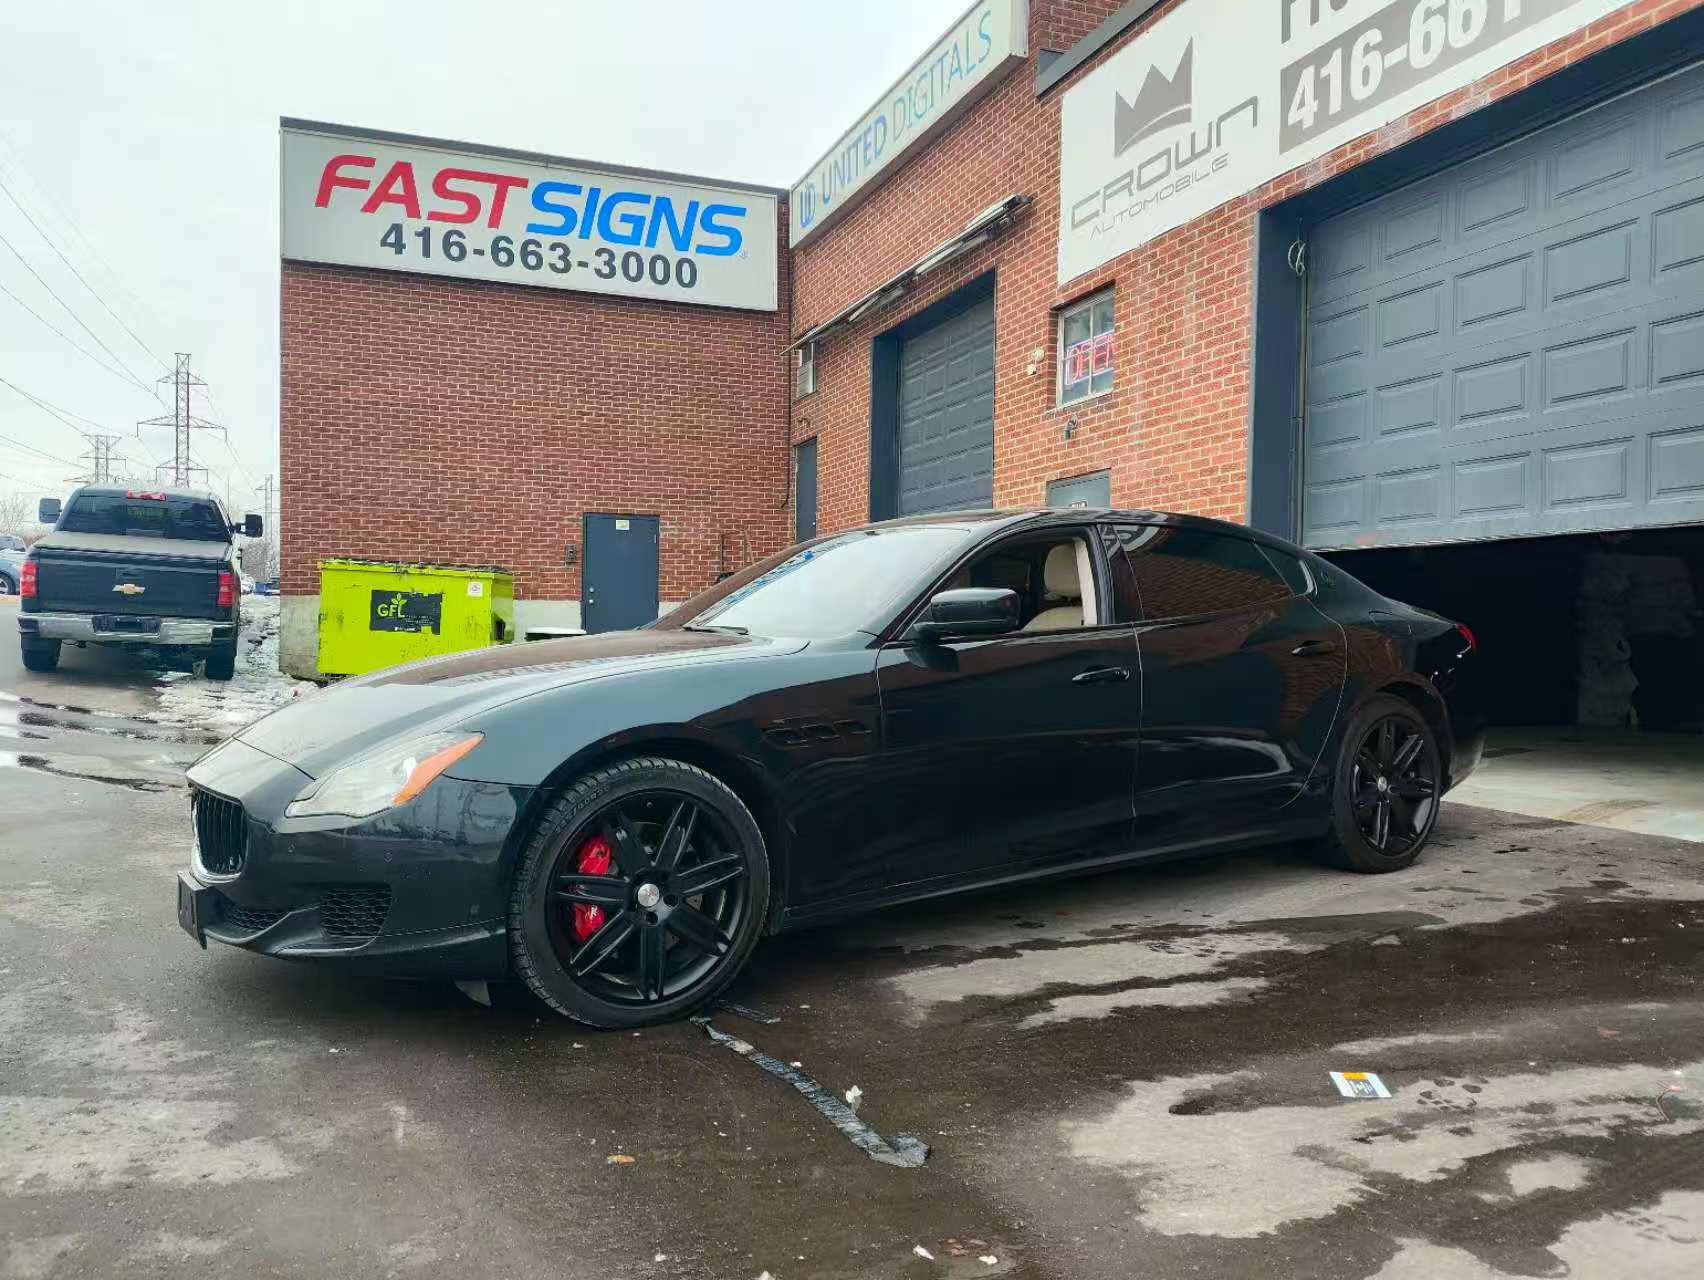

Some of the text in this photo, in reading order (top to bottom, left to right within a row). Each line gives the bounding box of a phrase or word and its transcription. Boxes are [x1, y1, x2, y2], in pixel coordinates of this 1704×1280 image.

[822, 115, 887, 205] UNITED
[893, 10, 992, 142] DIGITALS
[1071, 96, 1258, 231] CROWN
[1090, 152, 1228, 240] AUTOMOBILE
[380, 223, 698, 288] 416-663-3000
[377, 603, 405, 619] GFL
